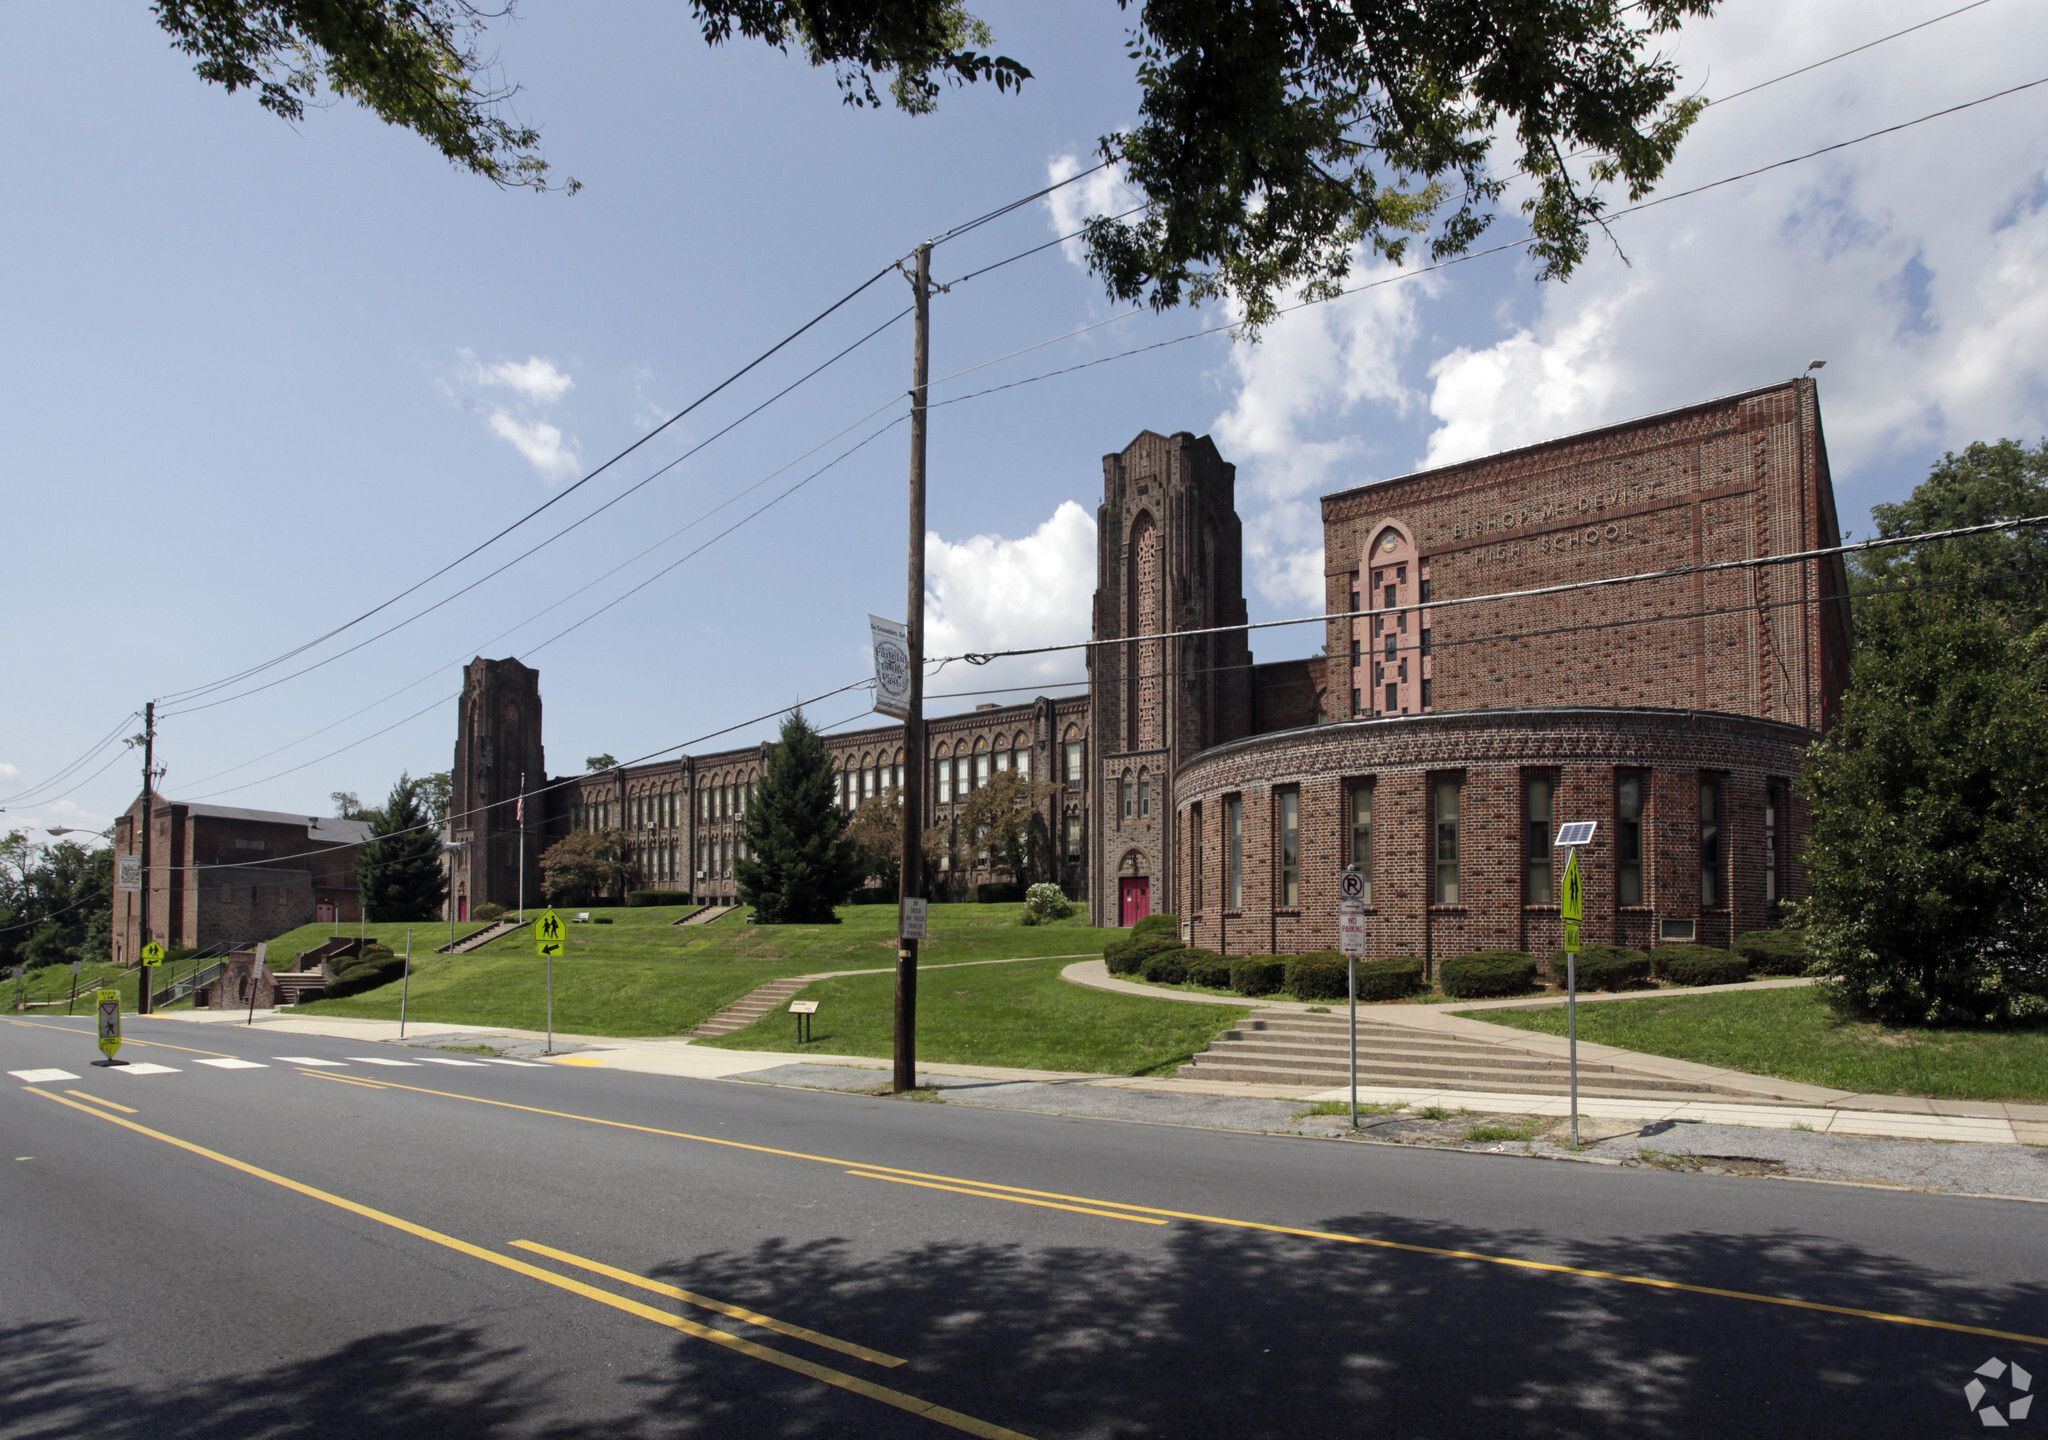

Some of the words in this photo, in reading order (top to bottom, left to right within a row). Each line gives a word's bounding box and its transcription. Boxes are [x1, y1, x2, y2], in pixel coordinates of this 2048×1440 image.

[1453, 510, 1528, 537] BISHOP
[1578, 482, 1656, 511] DEVITT
[1475, 543, 1521, 564] HIGH
[1541, 523, 1632, 551] SCHOOL
[875, 646, 908, 664] Faithful
[889, 663, 905, 676] the
[1348, 917, 1357, 925] NO
[1341, 925, 1363, 933] PARKING
